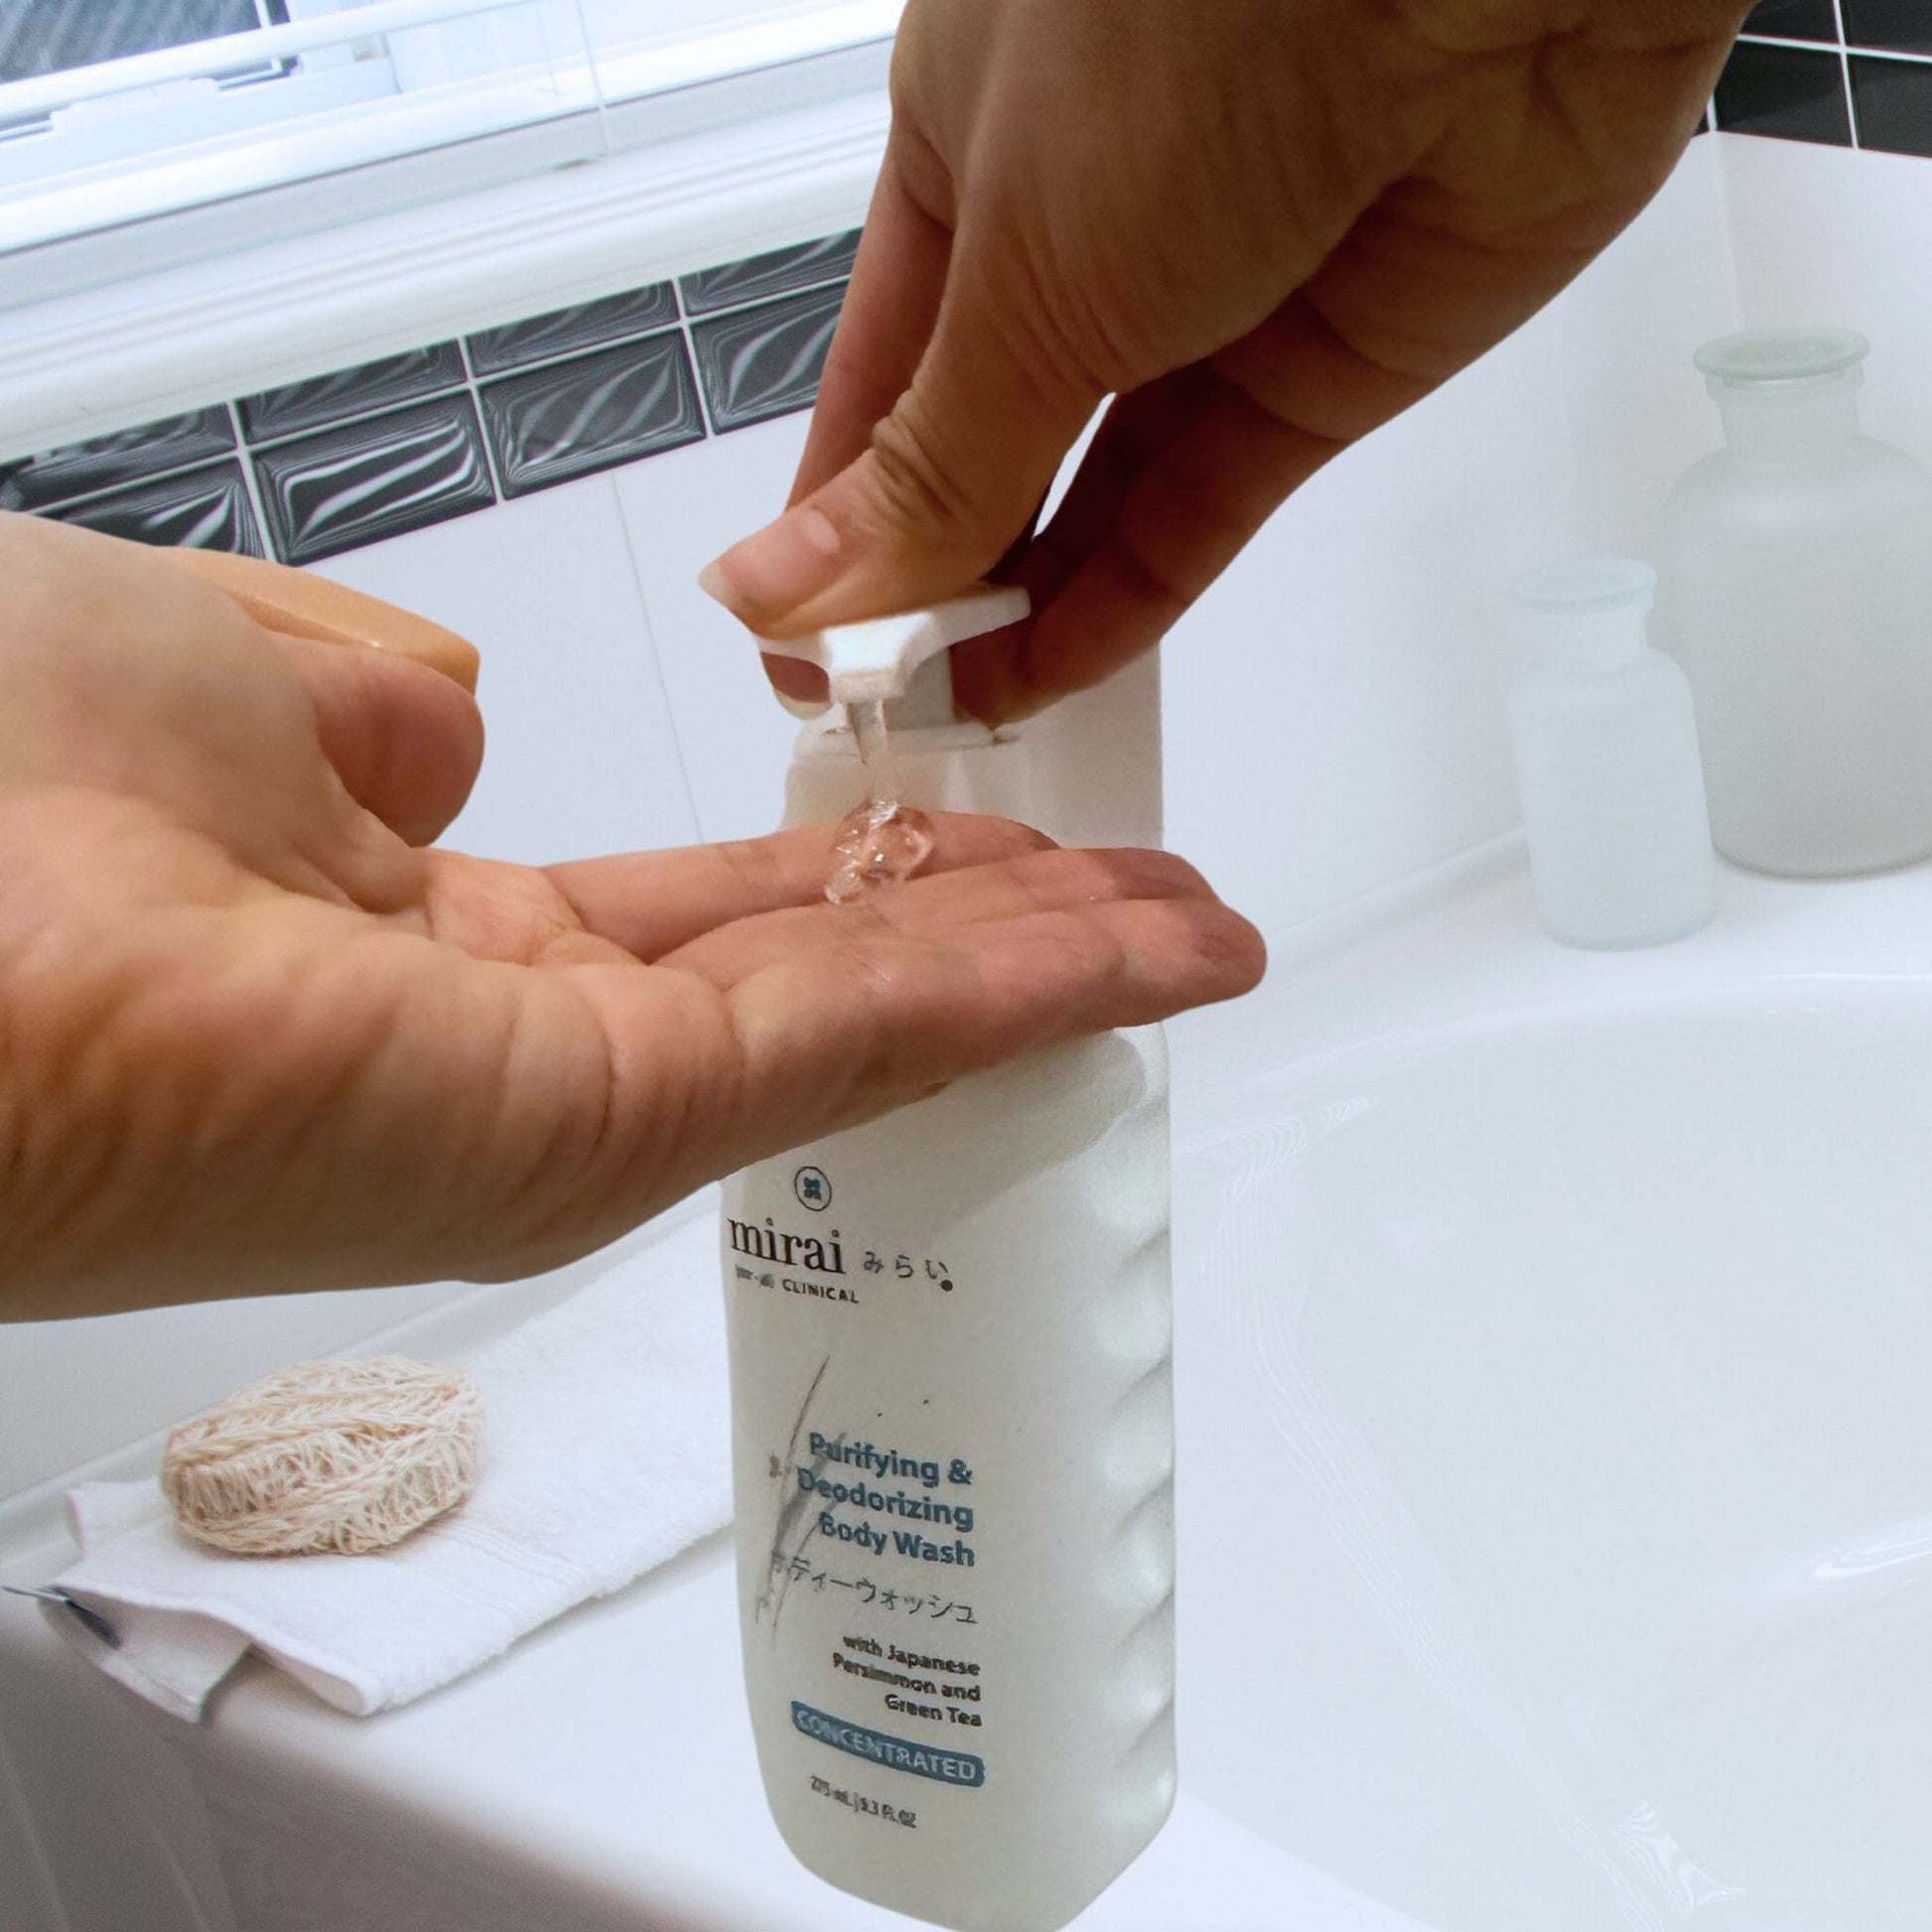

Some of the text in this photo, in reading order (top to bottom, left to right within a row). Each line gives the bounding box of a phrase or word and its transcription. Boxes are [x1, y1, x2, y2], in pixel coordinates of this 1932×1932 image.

[726, 1216, 847, 1275] mirai
[863, 1251, 949, 1280] みらい
[781, 1278, 859, 1305] CLINICAL
[809, 1431, 973, 1488] Purifying &
[796, 1464, 975, 1533] Deodorizing
[818, 1510, 976, 1568] Body Wash
[842, 1635, 982, 1677] with Japanese
[884, 1693, 983, 1727] Green Tea
[940, 1684, 982, 1703] and
[795, 1710, 978, 1781] CONCENTRATED
